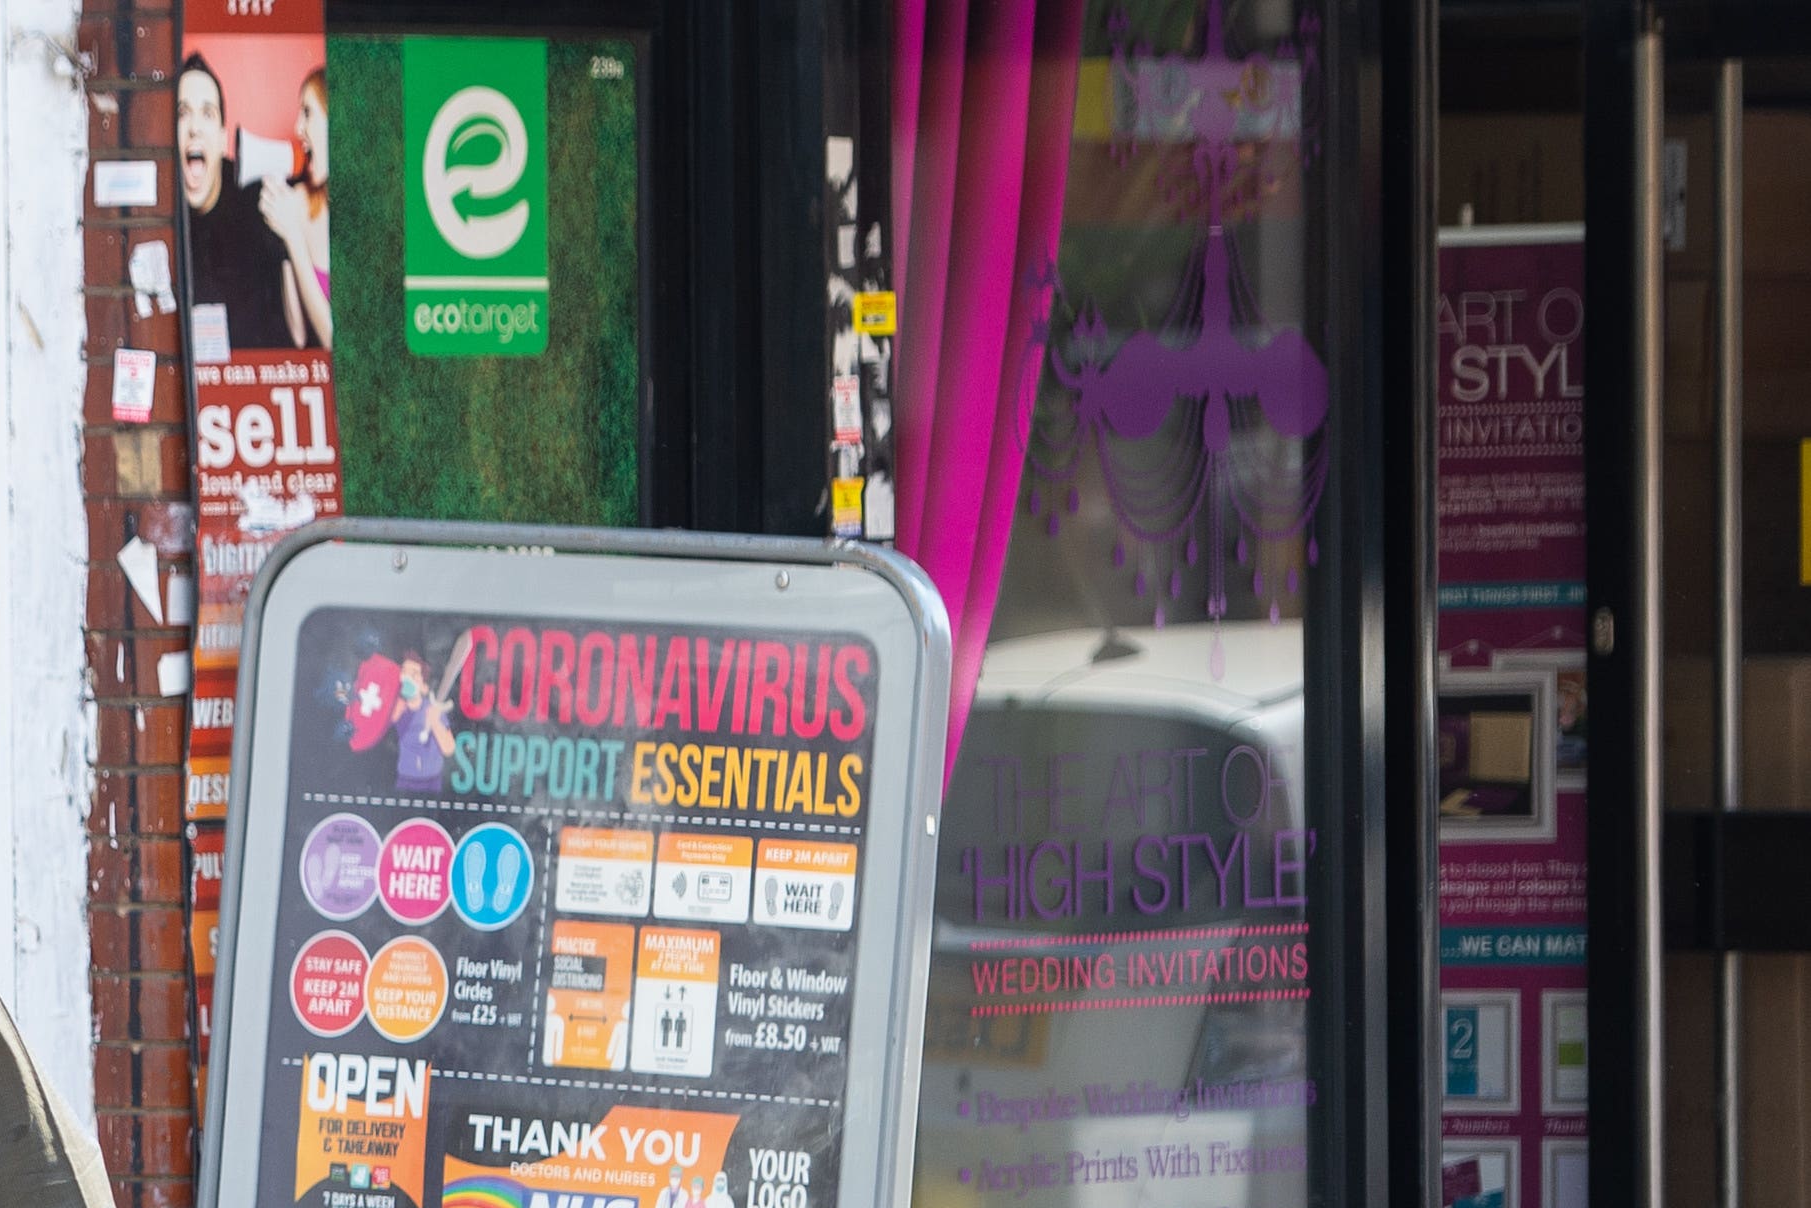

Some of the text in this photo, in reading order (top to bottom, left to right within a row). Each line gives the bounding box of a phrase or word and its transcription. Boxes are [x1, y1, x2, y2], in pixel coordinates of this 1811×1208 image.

[414, 299, 539, 343] ecotarget
[196, 359, 330, 385] we can make it
[198, 386, 335, 468] sell
[201, 469, 336, 497] loud clear
[463, 625, 871, 741] CORONAVIRUS
[449, 732, 862, 816] SUPPORT ESSENTIALS
[981, 744, 1293, 833] THE ART OF
[392, 844, 445, 872] WAIT
[765, 847, 792, 863] KEEP
[812, 852, 850, 866] APART
[389, 872, 442, 900] HERE
[785, 882, 824, 897] WAIT
[783, 898, 822, 914] HERE
[645, 934, 714, 955] MAXIMUM
[1460, 934, 1492, 957] WE
[1496, 934, 1539, 957] CAN
[305, 956, 362, 975] STAY SAFE
[456, 956, 522, 984] Floor Vinyl
[730, 963, 847, 994] Floor & Window
[970, 942, 1309, 995] WEDDING INVITATIONS
[303, 978, 360, 999] KEEP 2M
[454, 980, 493, 1003] Circles
[308, 998, 352, 1017] APART
[376, 1004, 432, 1022] DISTANCE
[472, 1004, 497, 1025] £25
[729, 991, 825, 1021] Vinyl Stickers
[725, 1022, 841, 1053] from £8.50 VAT
[1452, 1018, 1473, 1059] 2
[307, 1052, 427, 1119] OPEN
[319, 1117, 406, 1140] FOR DELIVERY
[468, 1114, 701, 1167] THANK YOU
[510, 1161, 656, 1187] DOCTORS AND NURSES
[749, 1148, 811, 1185] YOUR
[1065, 1149, 1138, 1185] Prints
[1145, 1144, 1201, 1178] With
